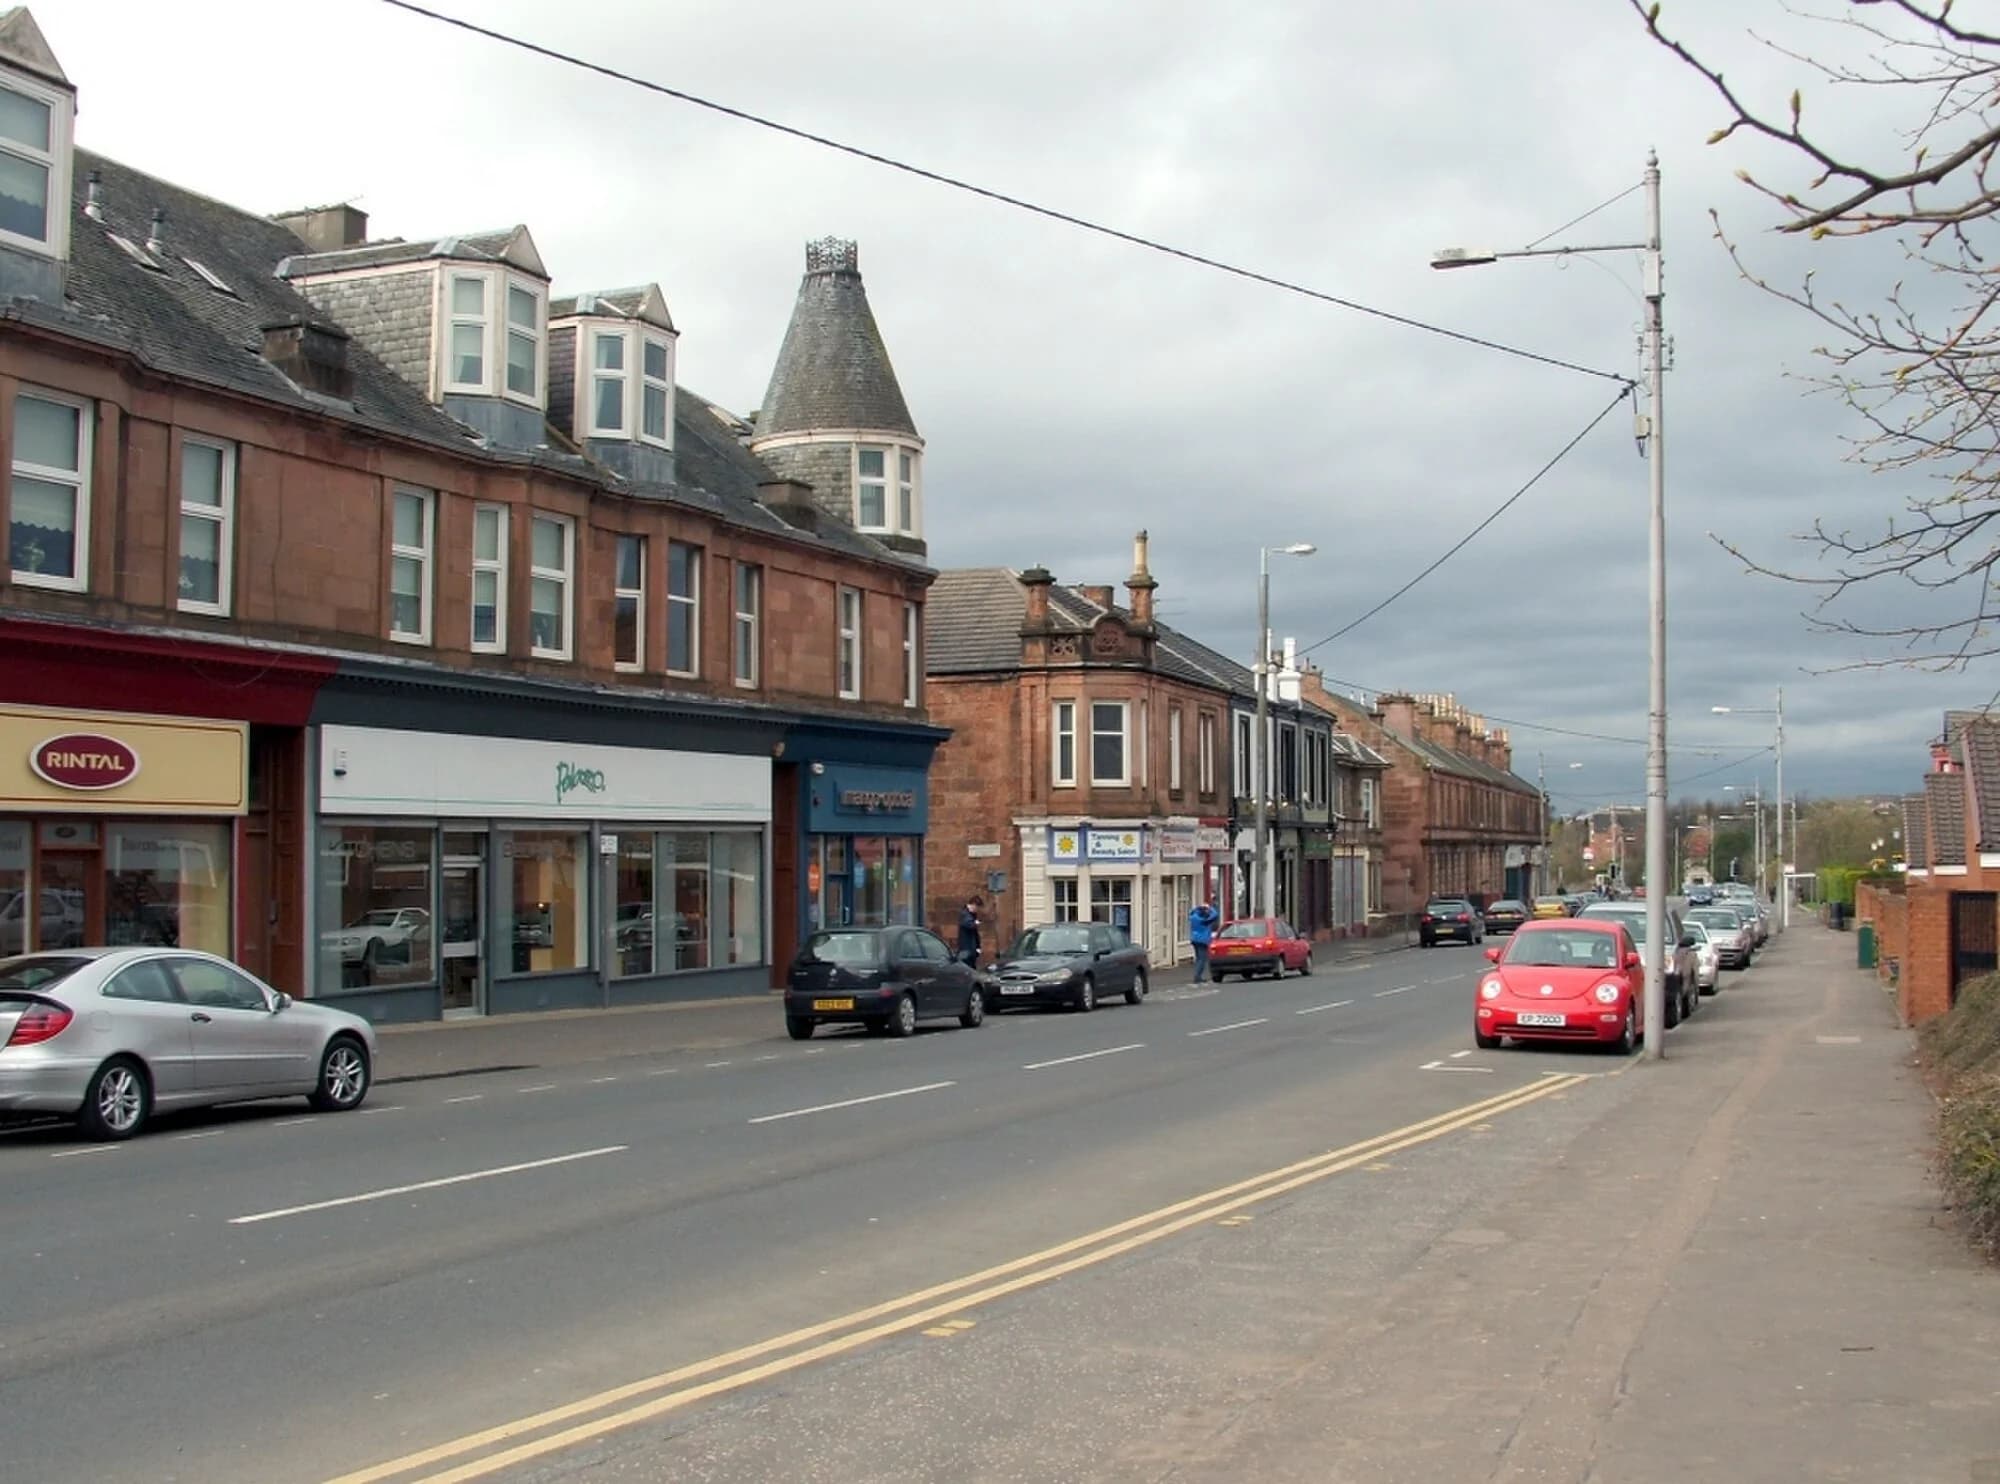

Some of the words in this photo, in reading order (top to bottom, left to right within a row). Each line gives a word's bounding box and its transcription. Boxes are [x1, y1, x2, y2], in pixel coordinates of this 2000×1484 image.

[46, 751, 125, 771] RINTAL
[1091, 833, 1120, 842] Tanning
[1091, 848, 1116, 856] Beauty
[1117, 847, 1137, 855] Salon
